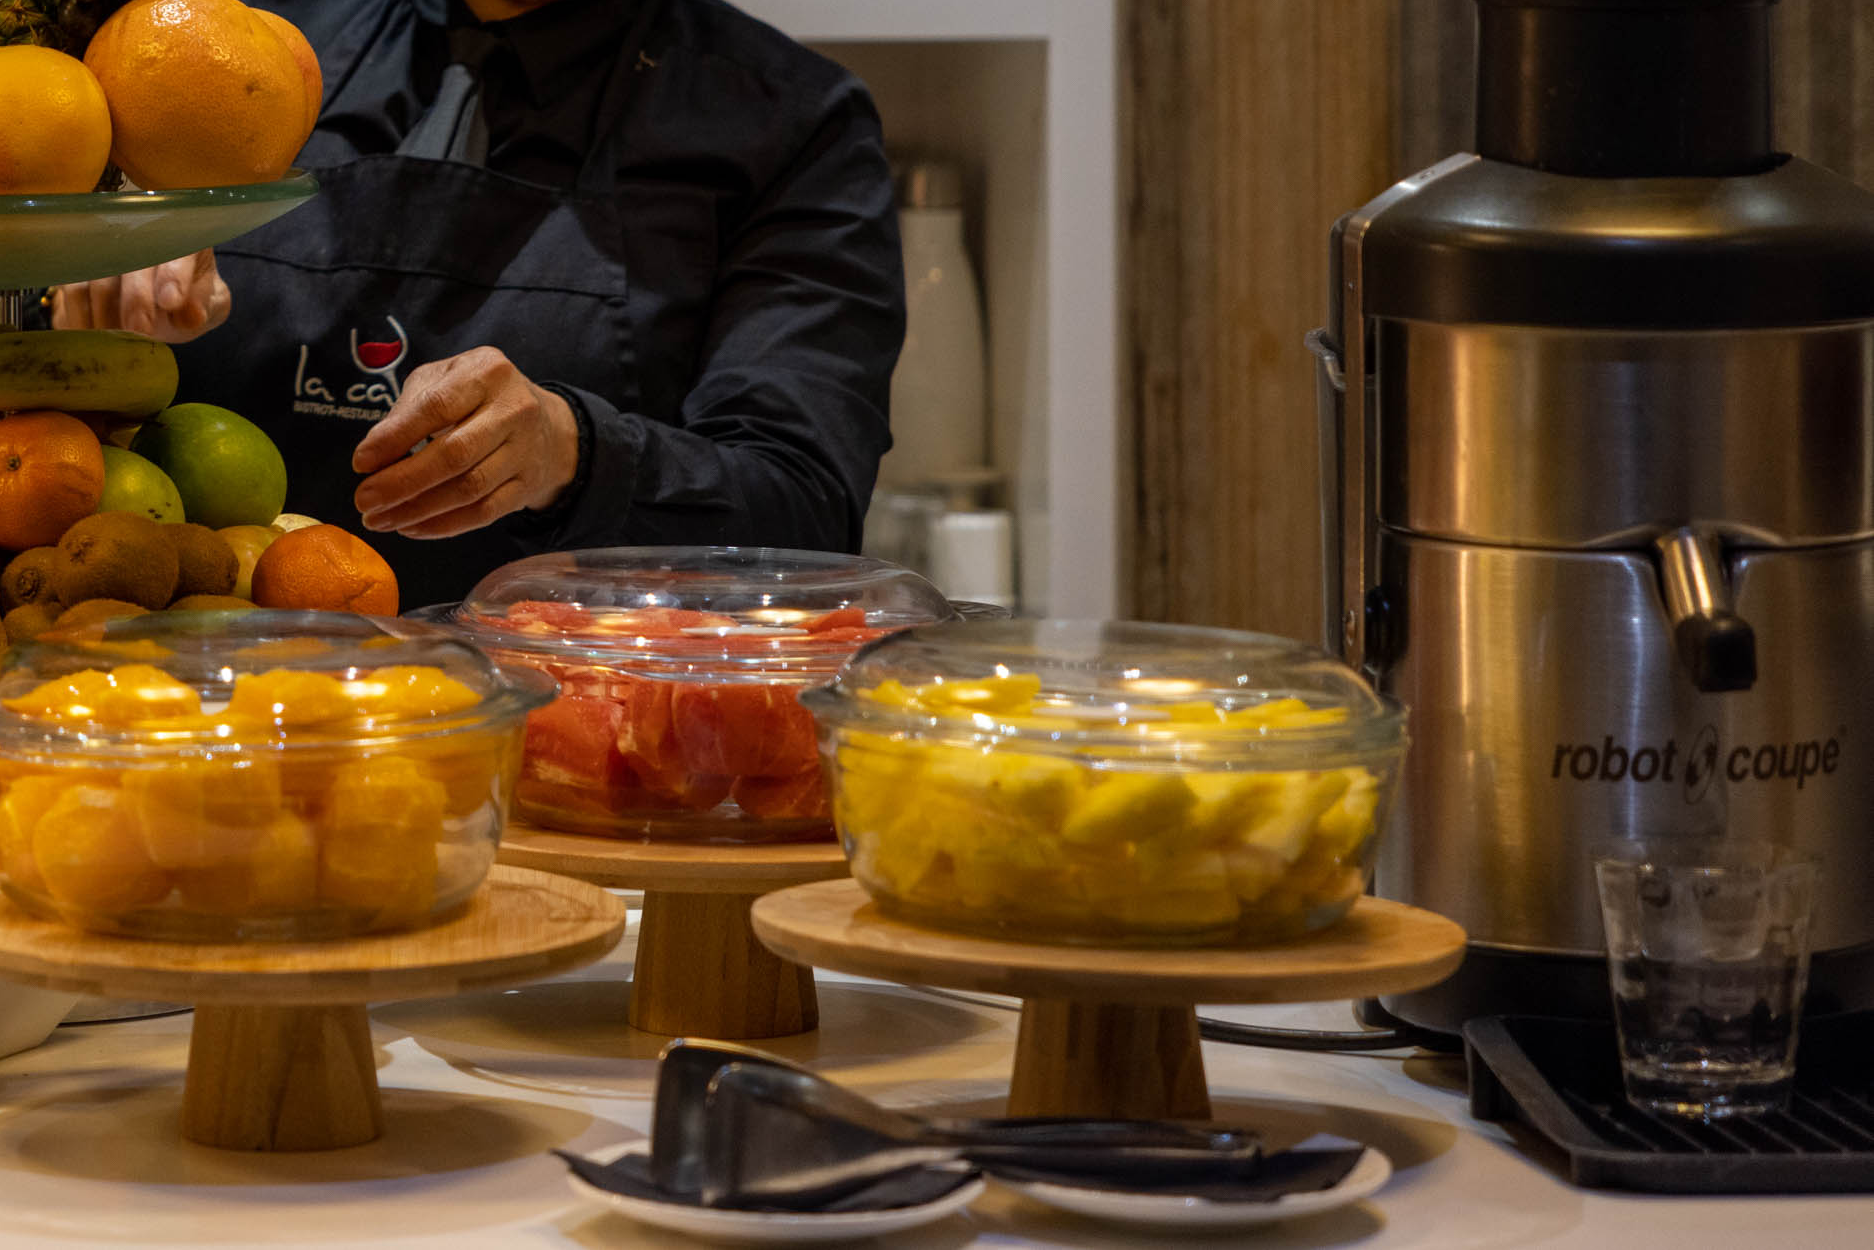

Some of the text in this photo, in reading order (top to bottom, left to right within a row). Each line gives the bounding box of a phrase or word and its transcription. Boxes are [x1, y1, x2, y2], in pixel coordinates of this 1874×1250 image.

[294, 344, 334, 400] la
[1552, 736, 1840, 789] robot coupe
